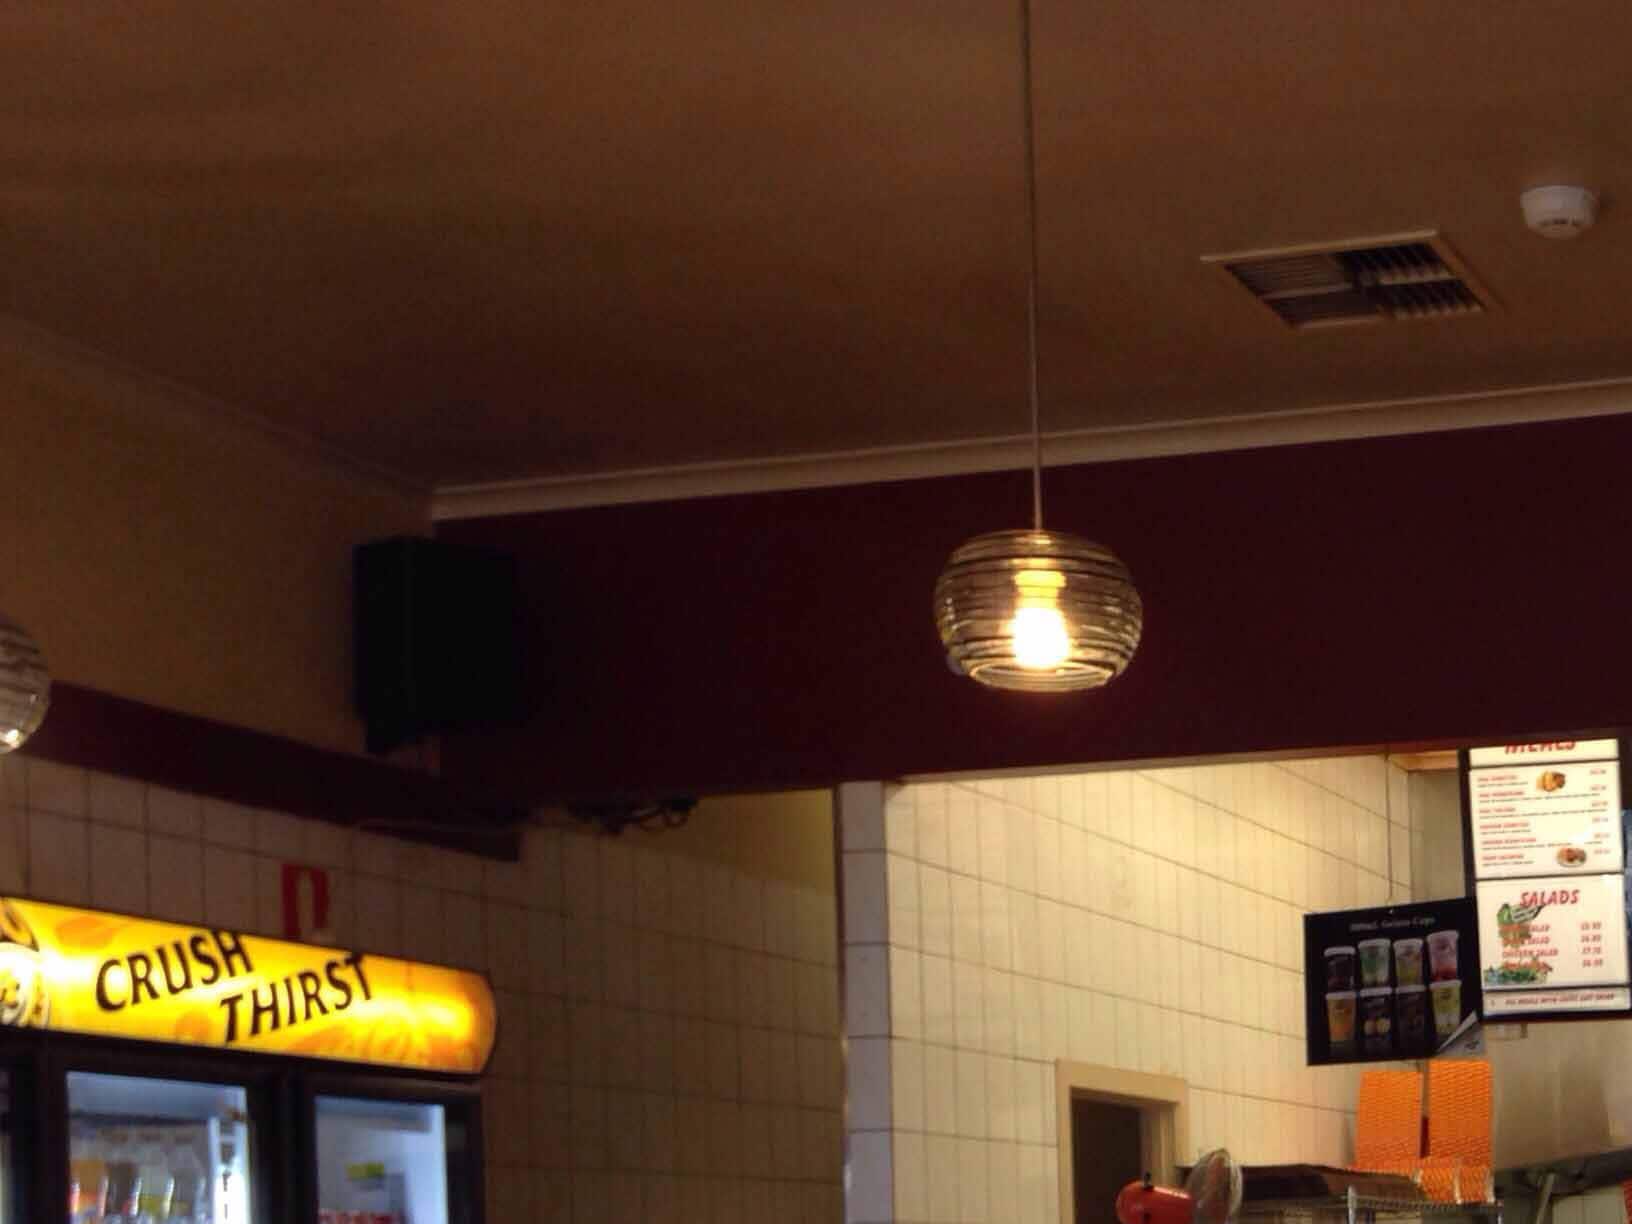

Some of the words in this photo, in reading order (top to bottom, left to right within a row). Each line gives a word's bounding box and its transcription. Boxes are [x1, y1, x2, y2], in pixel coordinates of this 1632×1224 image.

[1519, 889, 1580, 907] SALADS
[95, 930, 253, 1012] CRUSH
[219, 953, 373, 1047] THIRST
